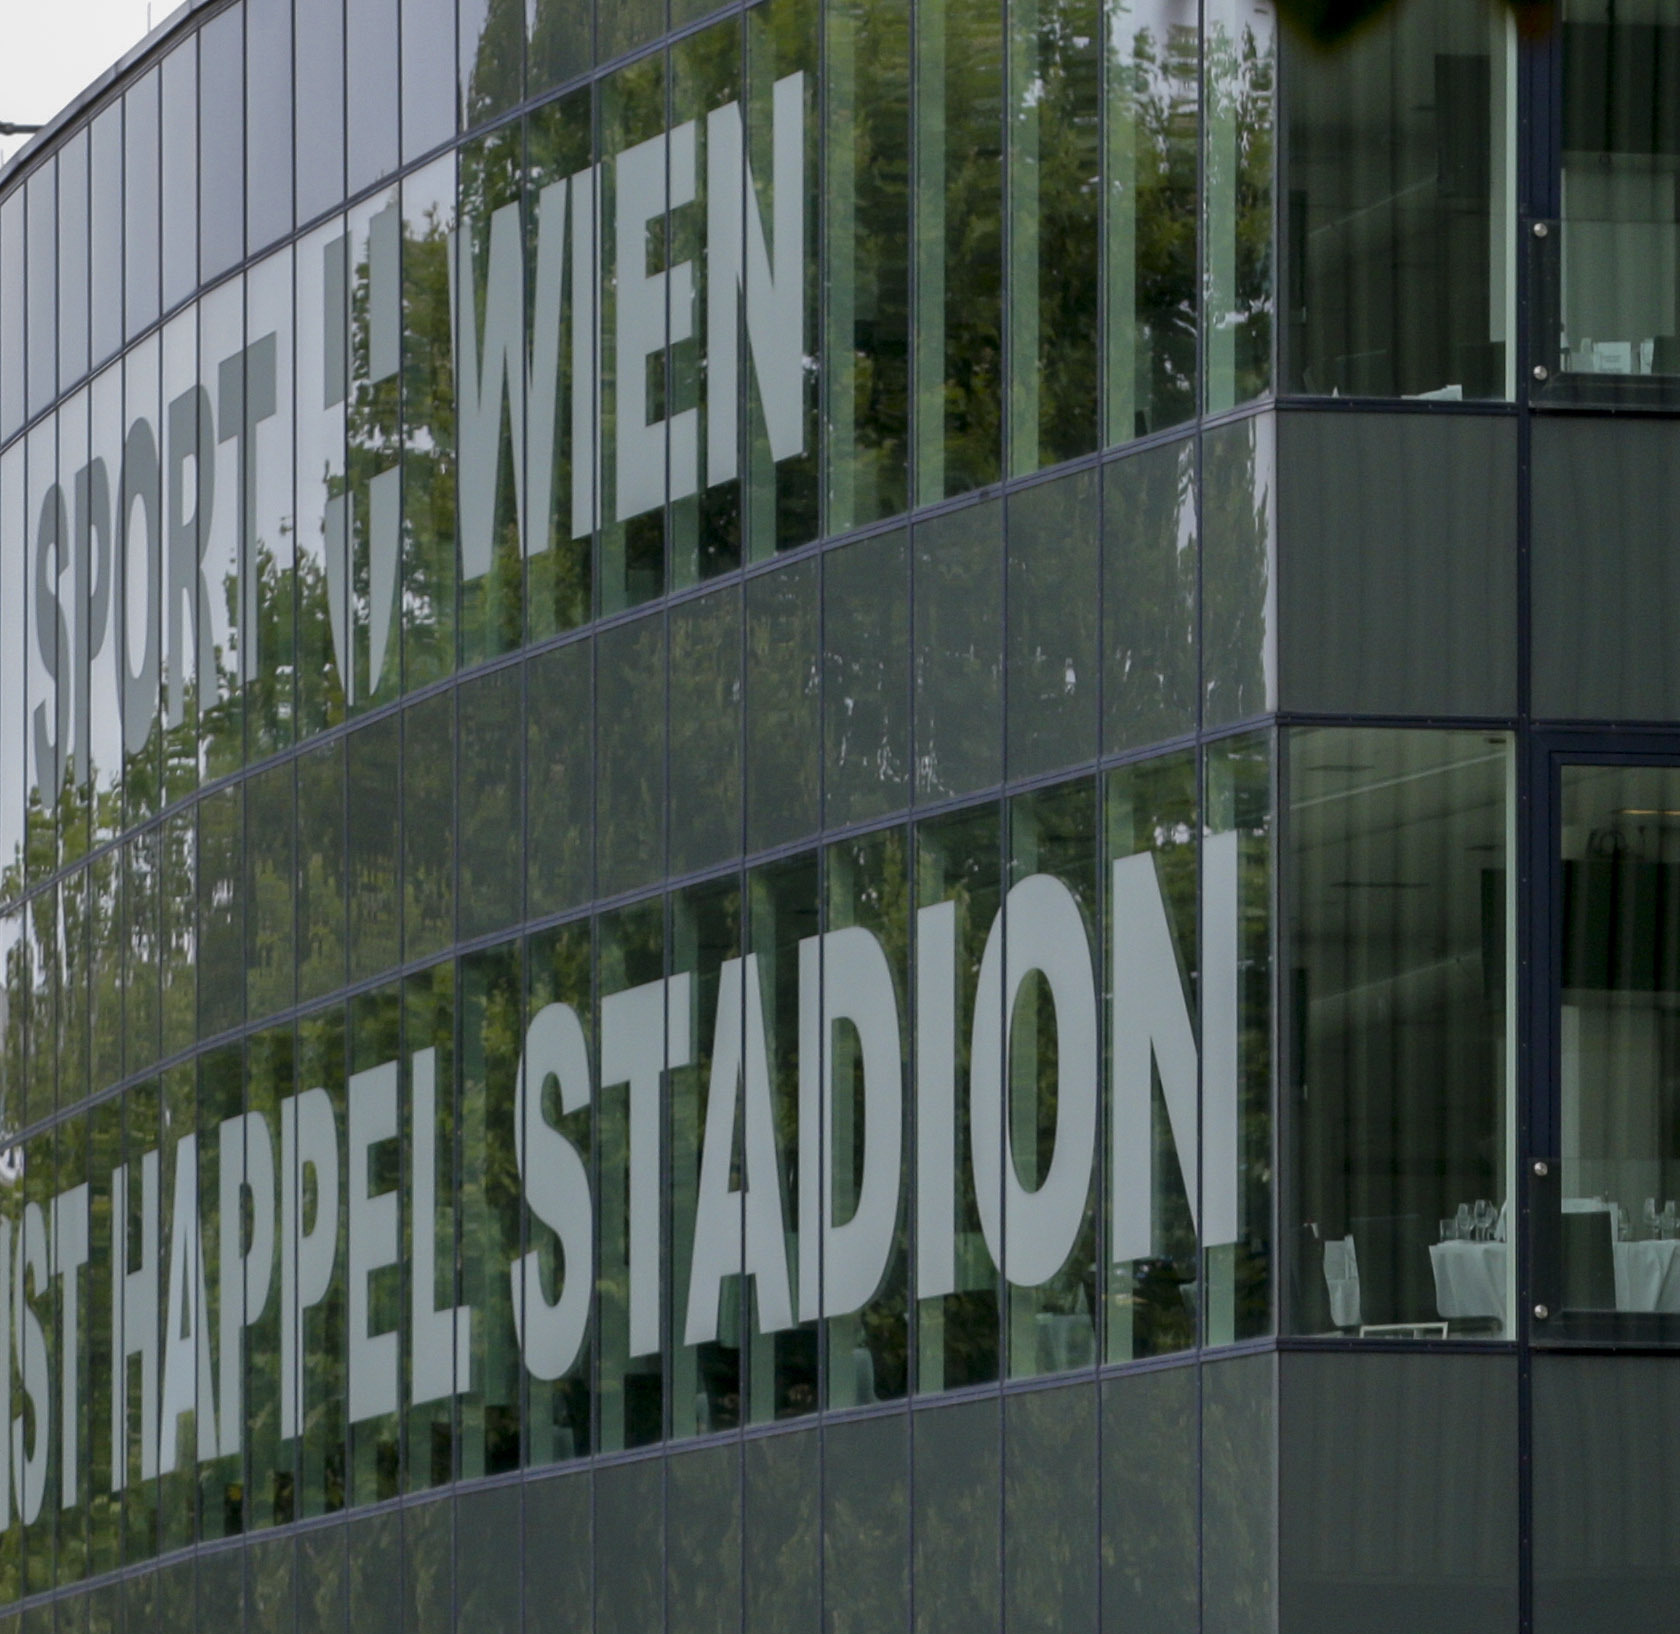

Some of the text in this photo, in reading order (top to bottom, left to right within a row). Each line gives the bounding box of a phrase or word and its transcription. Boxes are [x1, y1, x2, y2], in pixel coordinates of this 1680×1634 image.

[32, 69, 804, 809] SPORT WIEN
[110, 1045, 471, 1489] HAPPEL
[511, 828, 1239, 1382] STADION
